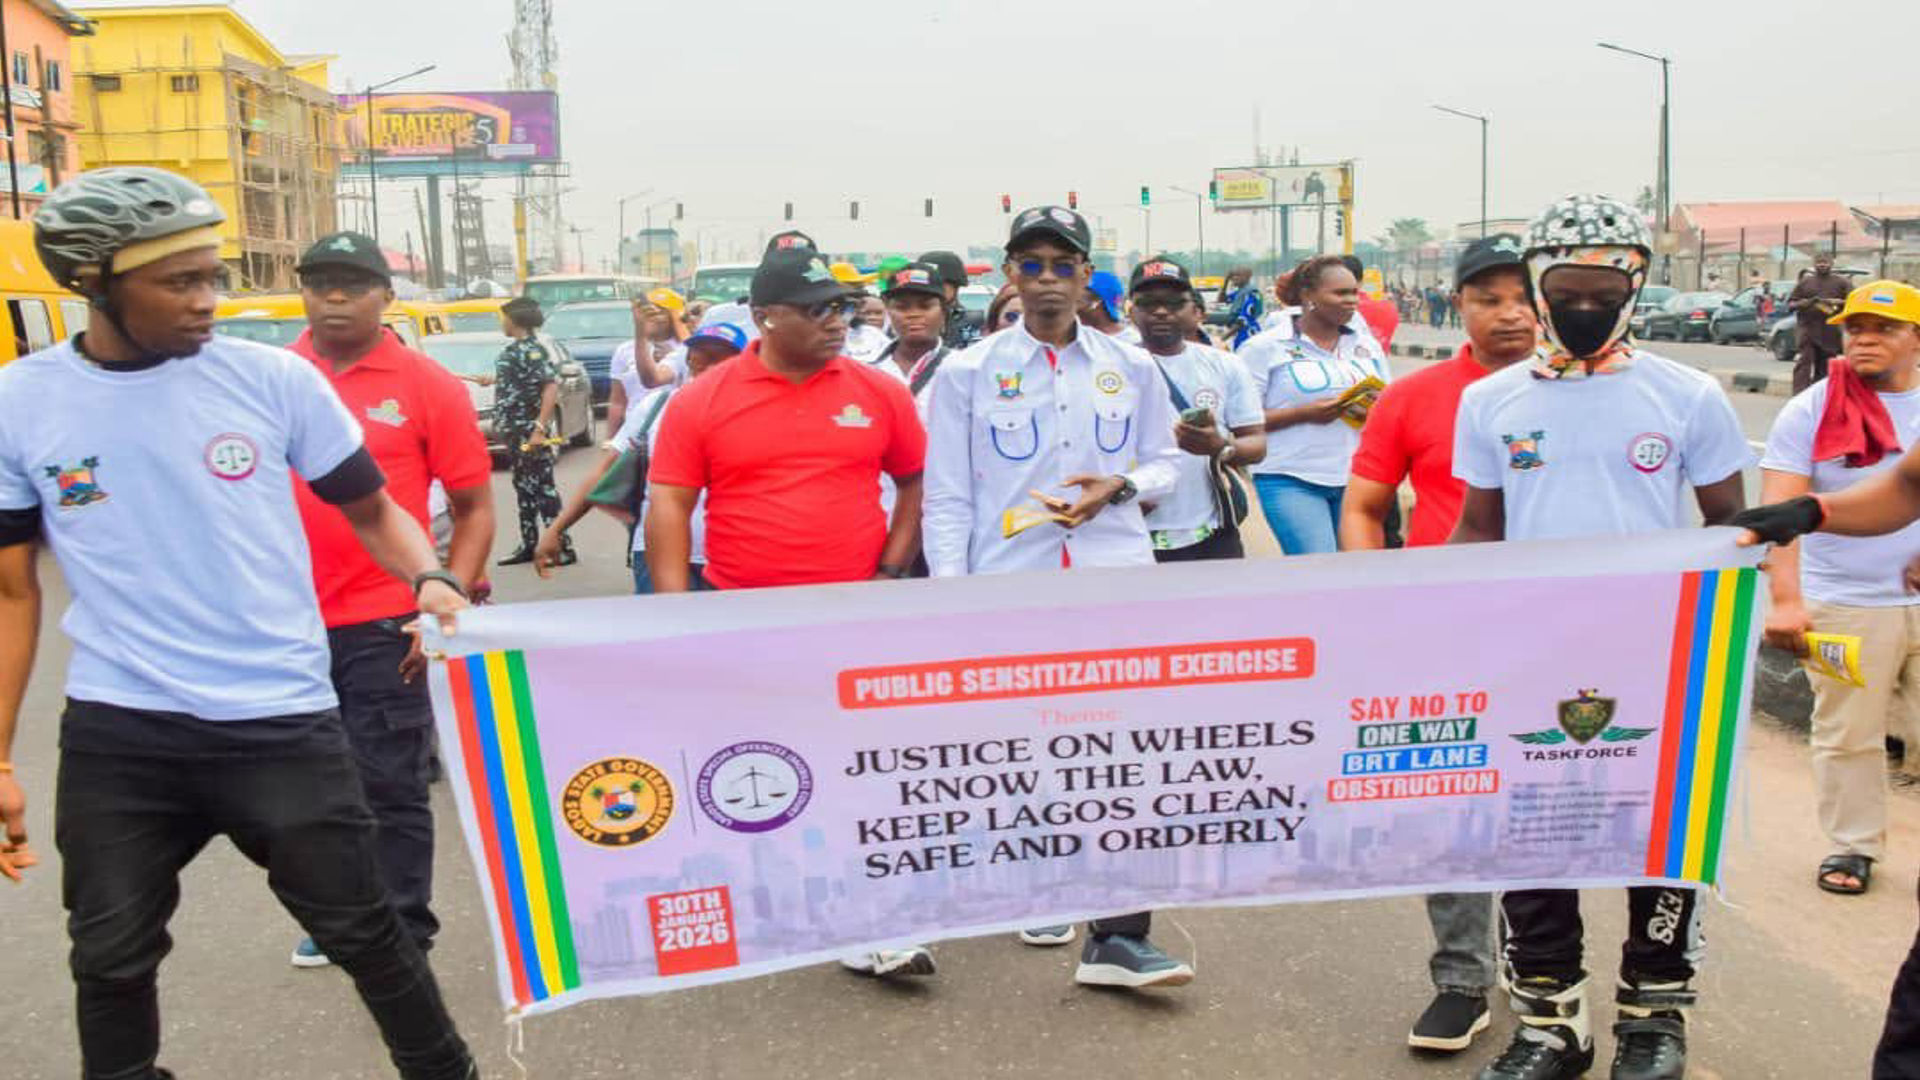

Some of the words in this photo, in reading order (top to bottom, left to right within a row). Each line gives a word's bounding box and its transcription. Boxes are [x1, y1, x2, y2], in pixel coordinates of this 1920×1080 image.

[476, 119, 493, 144] 5
[854, 673, 954, 701] PUBLIC
[961, 656, 1161, 695] SENSITIZATION
[1169, 647, 1298, 677] EXERCISE
[1350, 696, 1400, 721] SAY
[1409, 694, 1446, 717] NO
[1455, 691, 1488, 714] TO
[845, 738, 1033, 776] JUSTICE
[1048, 732, 1114, 758] ON
[1130, 719, 1316, 754] WHEELS
[1362, 724, 1410, 747] ONE
[1418, 719, 1472, 742] WAY
[1346, 752, 1401, 773] BRT
[1409, 747, 1484, 769] LANE
[1522, 746, 1638, 761] TASKFORCE
[573, 763, 606, 798] STATE
[899, 771, 1040, 806] KNOW
[1056, 763, 1145, 791] THE
[1161, 757, 1264, 785] LAW,
[1331, 772, 1496, 800] OBSTRUCTION
[610, 760, 674, 834] GOVERNMENT
[565, 801, 602, 842] LAGOS
[856, 811, 970, 844] KEEP
[988, 797, 1136, 830] LAGOS
[1152, 784, 1307, 815] CLEAN,
[865, 843, 975, 878] SAFE
[990, 834, 1082, 864] AND
[1099, 816, 1307, 853] ORDERLY
[657, 891, 721, 916] 30TH
[657, 908, 726, 930] JANUARY
[659, 922, 729, 951] 2026
